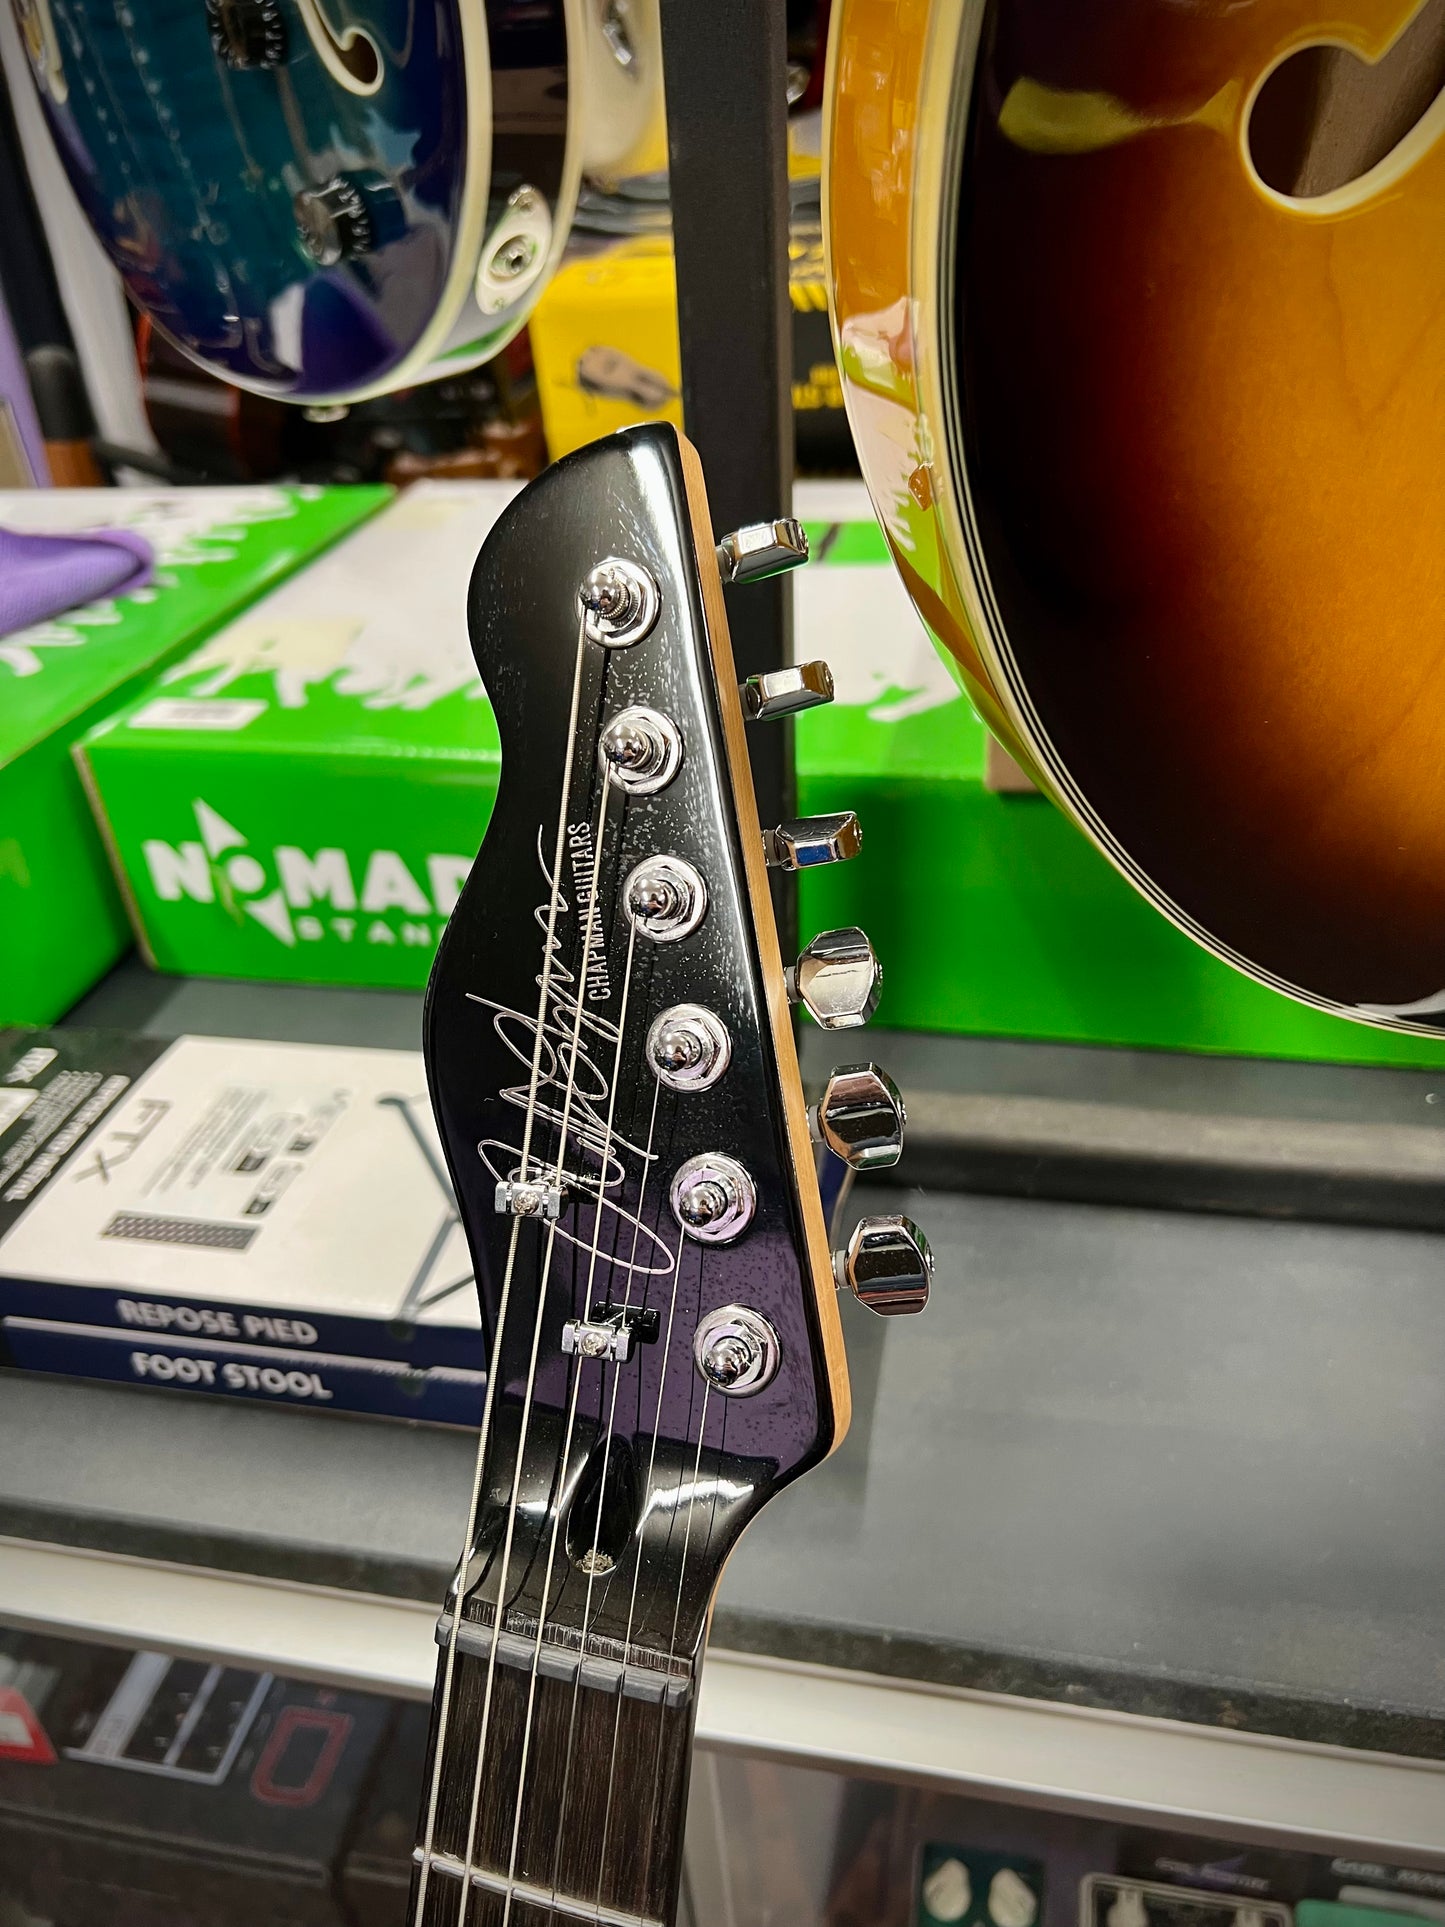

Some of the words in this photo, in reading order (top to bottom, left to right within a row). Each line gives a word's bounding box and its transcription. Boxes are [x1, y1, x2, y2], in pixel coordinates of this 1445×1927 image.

[567, 821, 599, 904] GUITARS
[294, 916, 450, 948] STAN
[577, 905, 611, 1001] CHAPMAN
[116, 1298, 240, 1337] REPOSE
[243, 1313, 319, 1346] PIED
[131, 1351, 216, 1385] FOOT
[222, 1363, 333, 1400] STOOL
